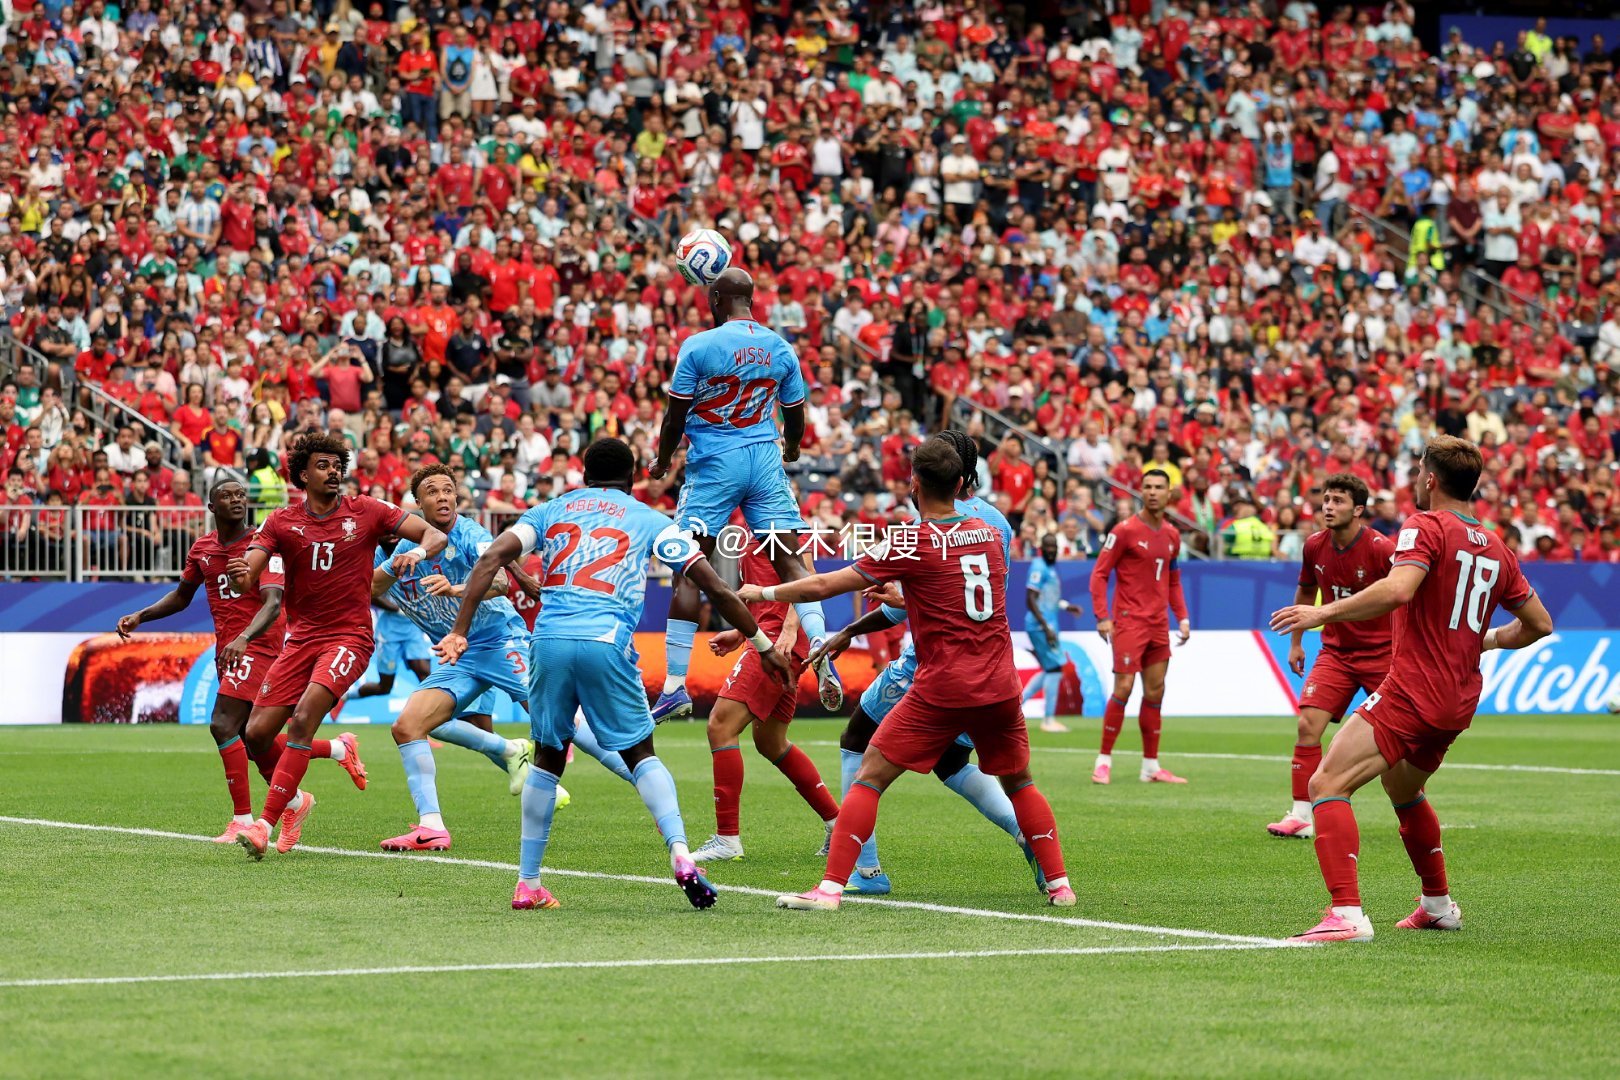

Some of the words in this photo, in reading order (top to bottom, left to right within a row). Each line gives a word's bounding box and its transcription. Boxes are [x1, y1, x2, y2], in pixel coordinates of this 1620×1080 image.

[733, 347, 771, 368] WISSA
[693, 374, 778, 429] 20
[565, 498, 626, 520] MBEMBA
[311, 541, 336, 571] 13
[543, 522, 631, 596] 22
[1155, 558, 1164, 581] 7
[217, 573, 242, 600] 2
[959, 552, 994, 623] 8
[1449, 549, 1500, 635] 18
[329, 645, 357, 676] 13
[506, 650, 527, 675] 3
[1478, 633, 1620, 713] Mich
